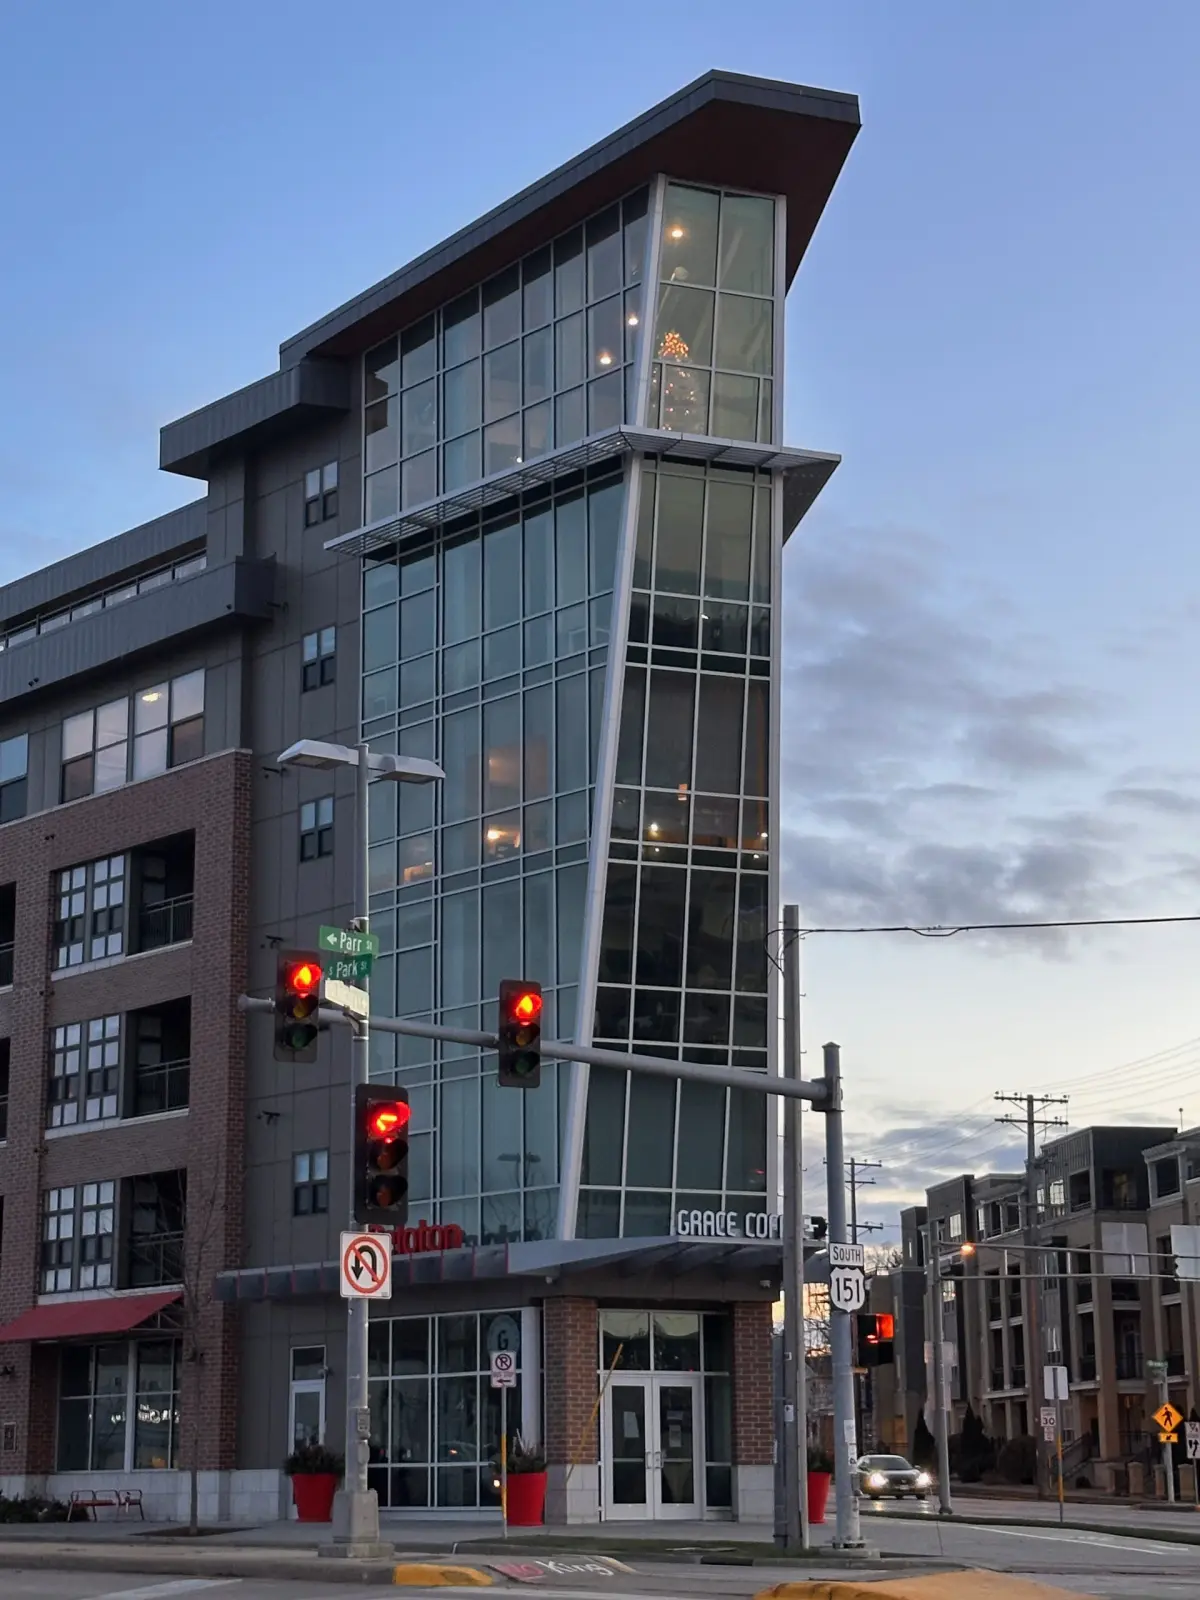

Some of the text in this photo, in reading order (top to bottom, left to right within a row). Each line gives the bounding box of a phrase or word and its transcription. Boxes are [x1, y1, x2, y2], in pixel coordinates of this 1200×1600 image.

[340, 931, 362, 952] Parr
[336, 961, 358, 979] Park
[677, 1209, 737, 1236] GRACE
[833, 1246, 861, 1262] SOUTH
[836, 1277, 860, 1303] 151
[1042, 1417, 1055, 1426] 30
